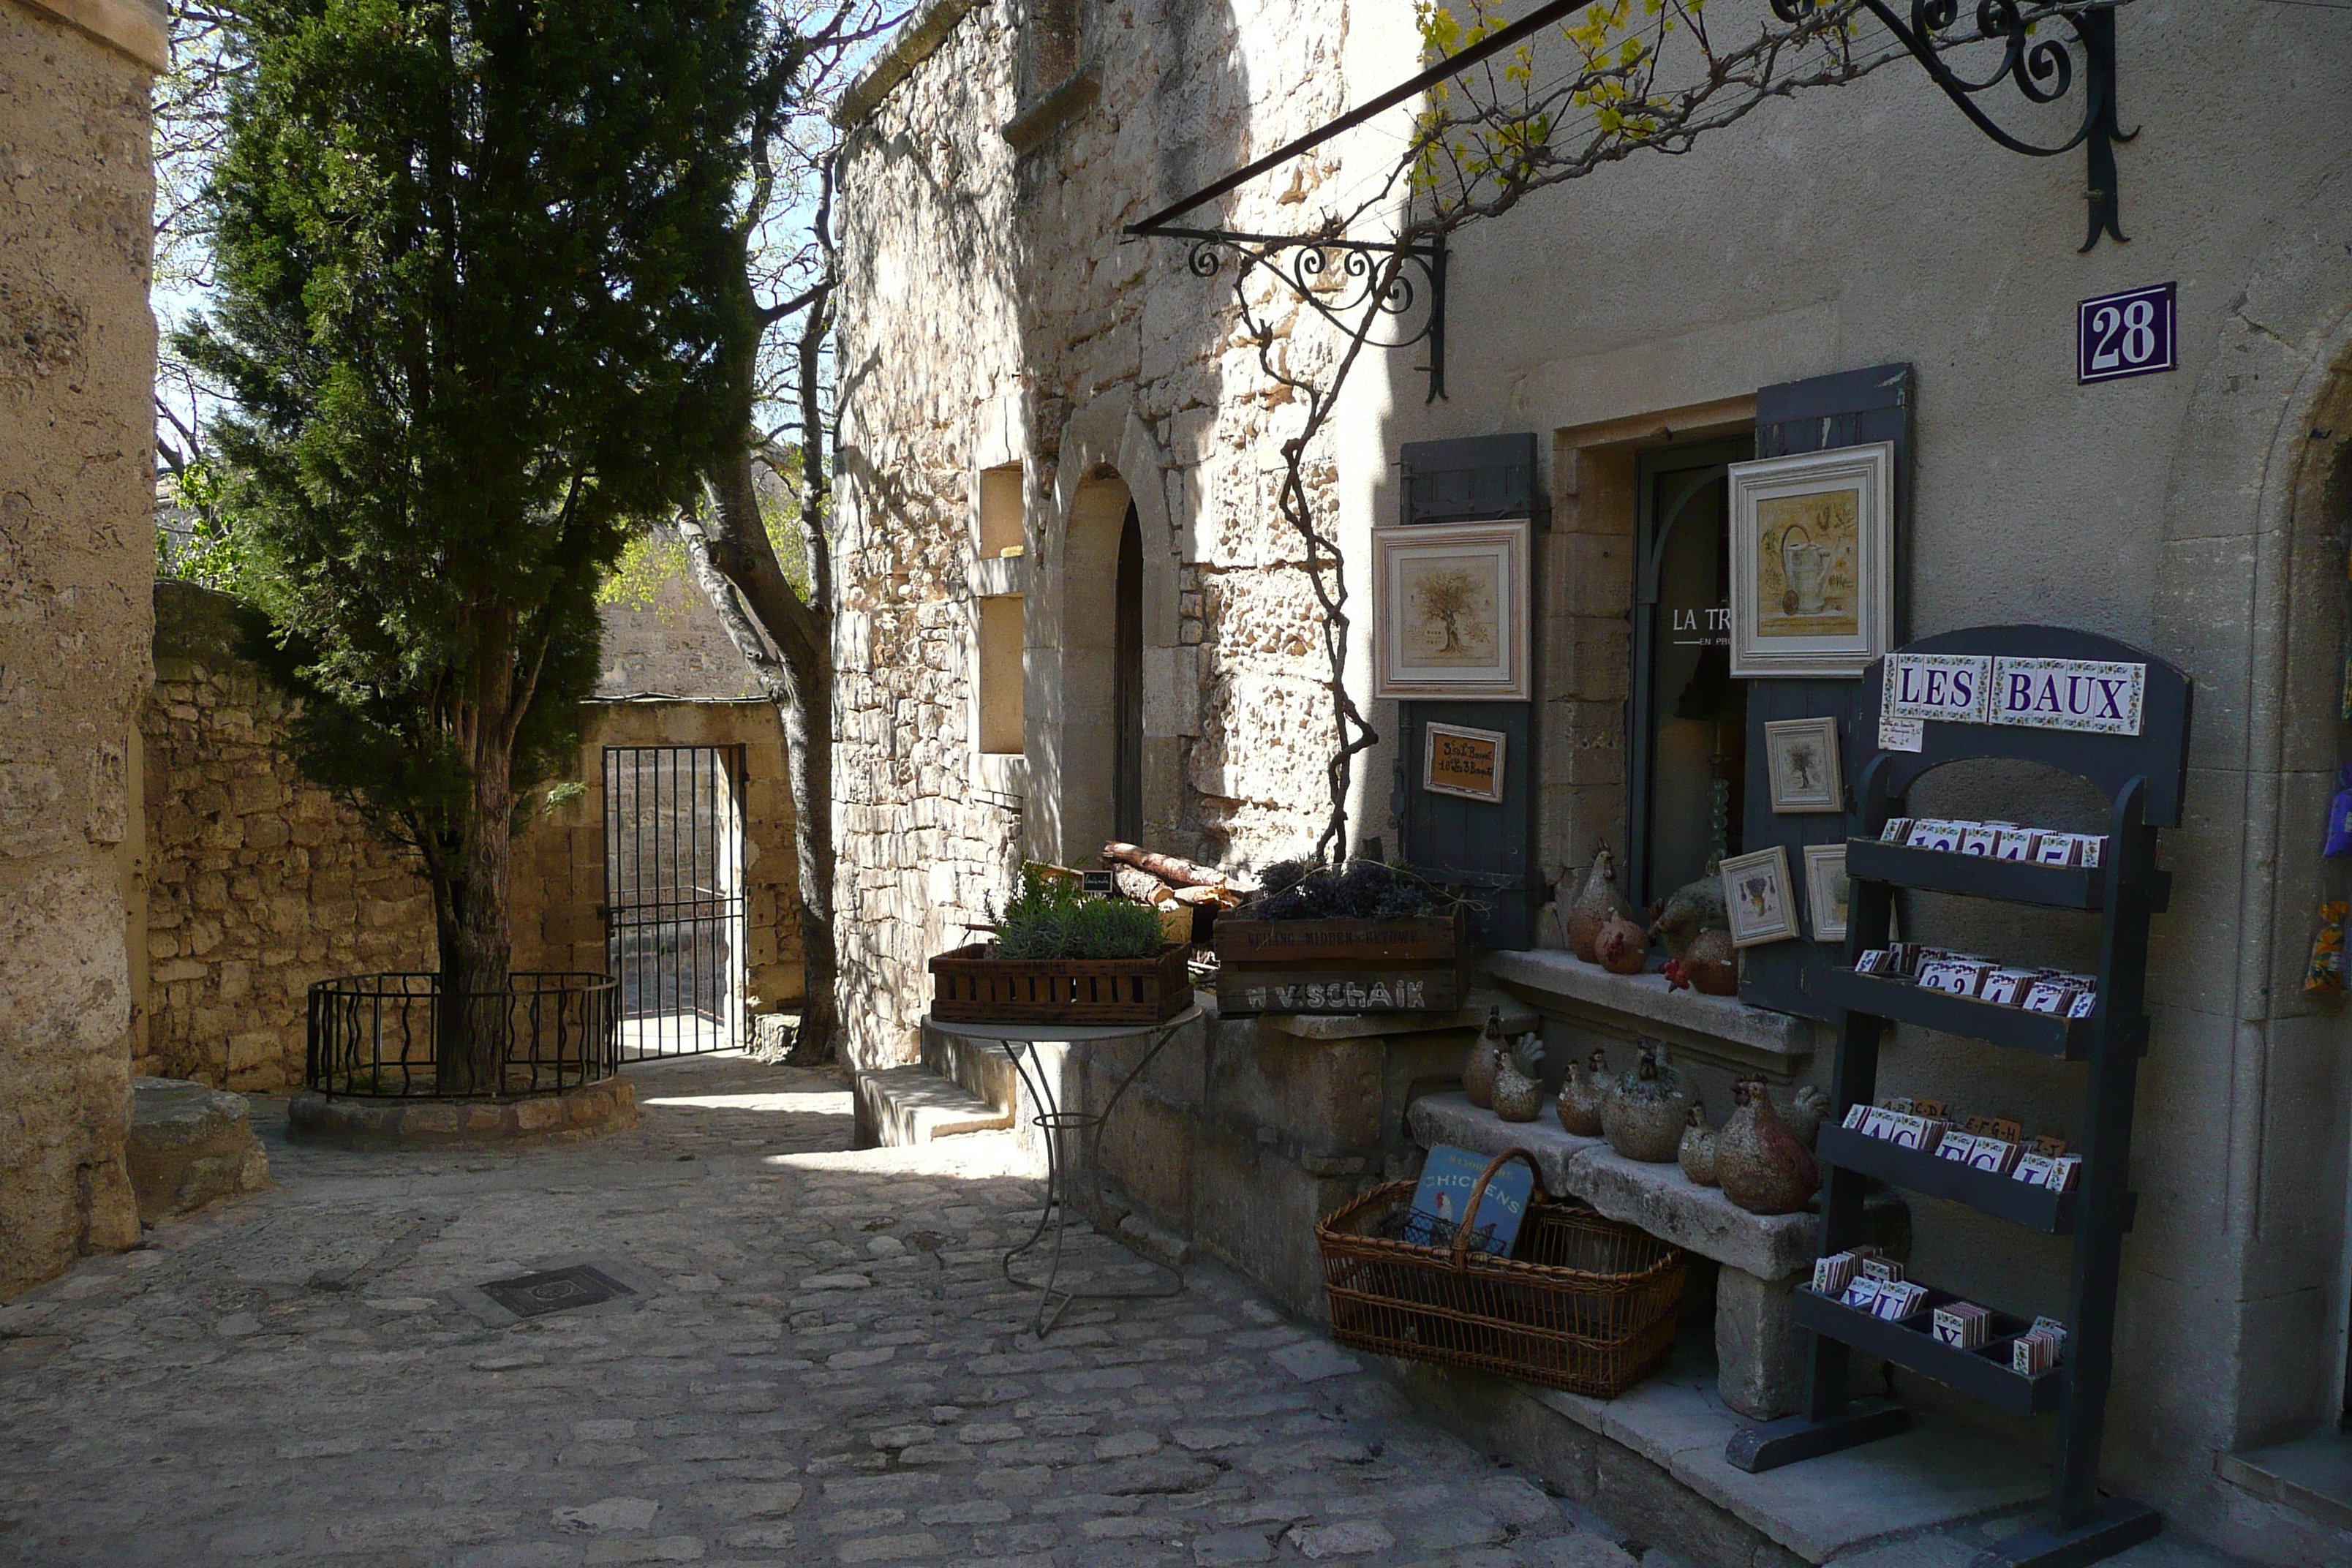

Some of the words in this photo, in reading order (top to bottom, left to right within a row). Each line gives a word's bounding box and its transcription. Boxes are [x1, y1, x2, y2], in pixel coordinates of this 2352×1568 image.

[2092, 300, 2155, 370] 28
[1673, 608, 1697, 630] LA
[1700, 638, 1711, 646] EN
[1899, 668, 1972, 707] LES
[2005, 673, 2127, 720] BAUX
